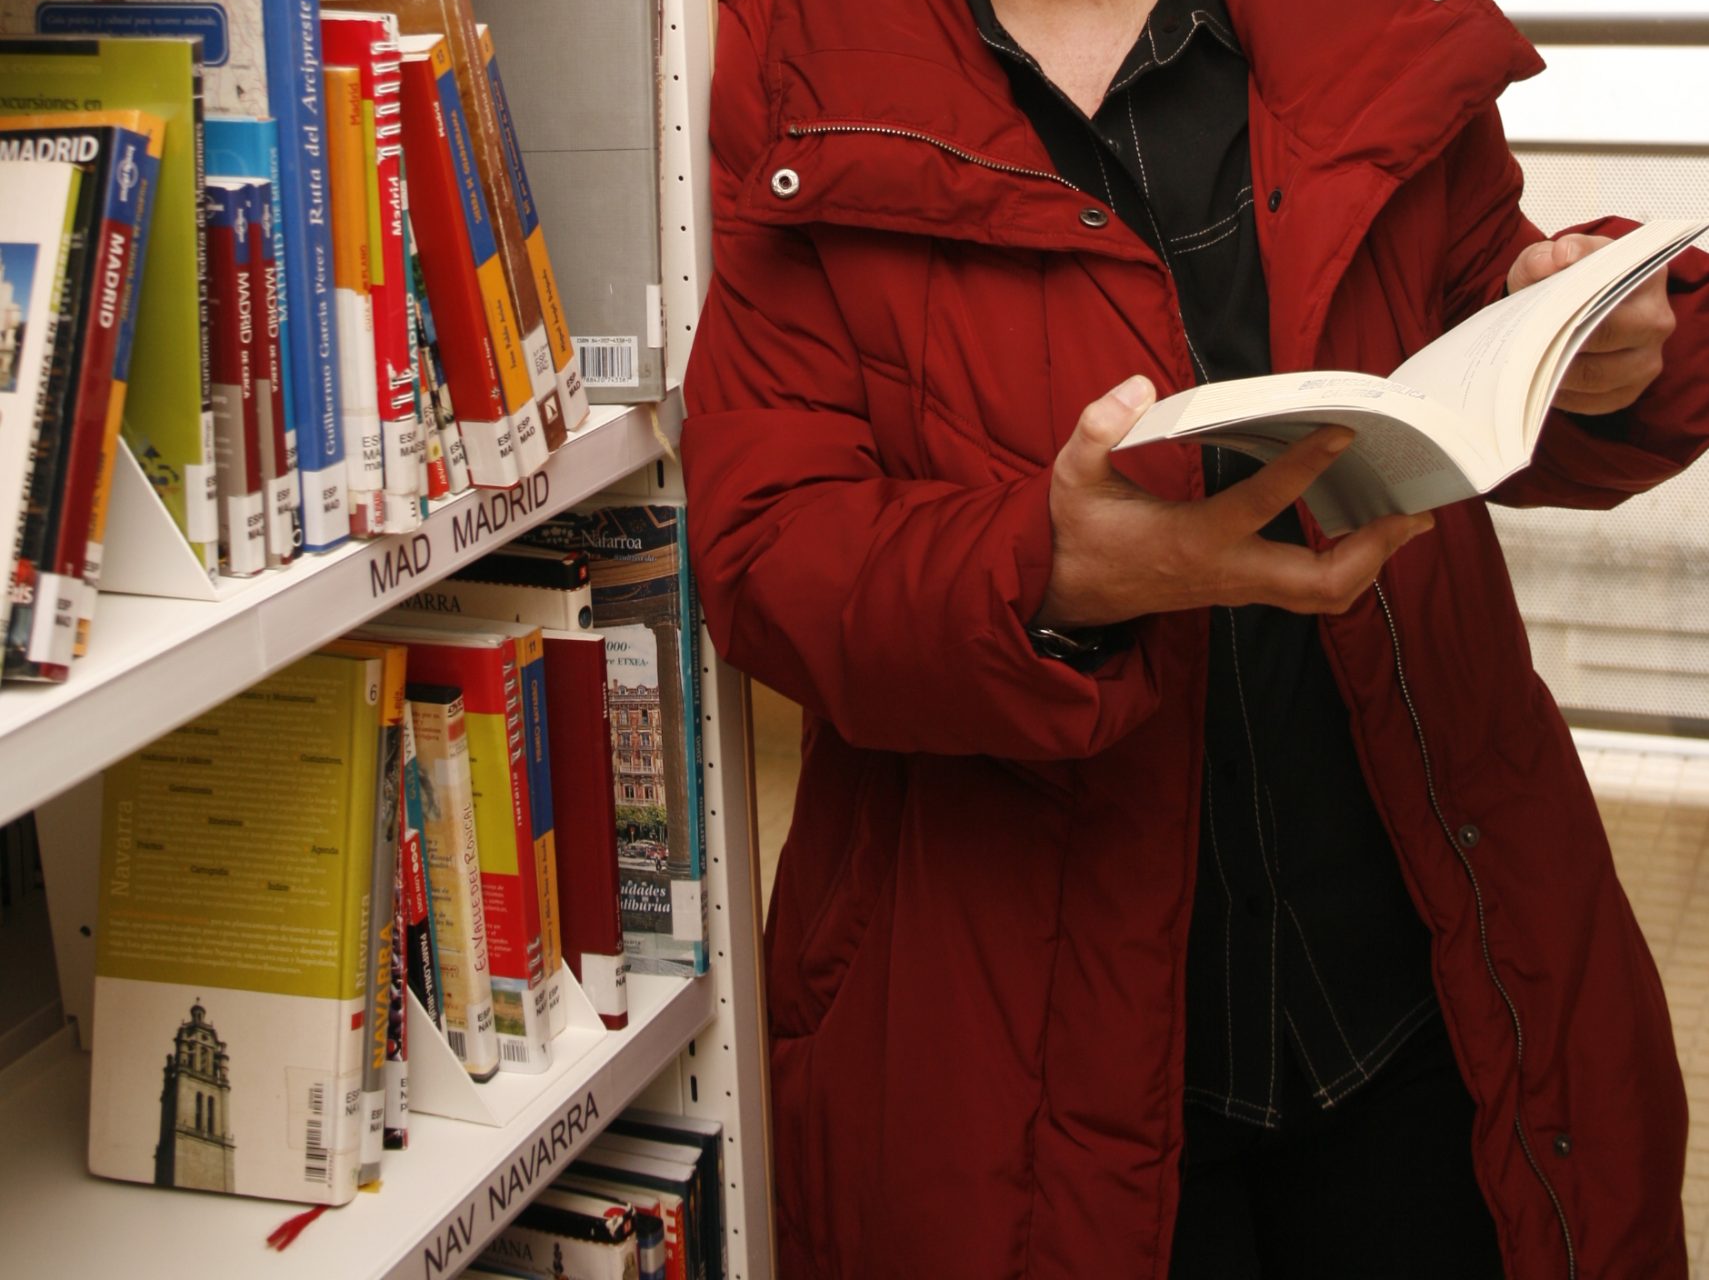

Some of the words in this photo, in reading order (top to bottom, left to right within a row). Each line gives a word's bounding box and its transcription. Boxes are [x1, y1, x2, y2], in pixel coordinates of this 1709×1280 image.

[300, 0, 320, 115] Arcipreste
[350, 82, 361, 126] Madrid
[0, 134, 100, 163] MADRID
[303, 125, 320, 157] del
[309, 167, 324, 226] Ruta
[388, 176, 402, 236] Madrid
[99, 231, 126, 329] MADRID
[237, 272, 253, 344] MADRID
[265, 267, 280, 338] MADRID
[406, 292, 420, 380] MADRID
[320, 363, 337, 456] Guillermo
[518, 416, 531, 433] ESP
[519, 426, 536, 444] MAD
[323, 485, 337, 500] ESP
[369, 533, 431, 598] MAD
[452, 470, 549, 553] MADRID
[581, 528, 642, 550] Nafarroa
[369, 684, 378, 702] 6
[111, 800, 135, 898] Navarra
[354, 893, 370, 990] Navarra
[372, 921, 393, 1069] NAVARRA
[477, 1006, 491, 1022] ESP
[423, 1203, 476, 1280] NAV
[488, 1091, 600, 1222] NAVARRA
